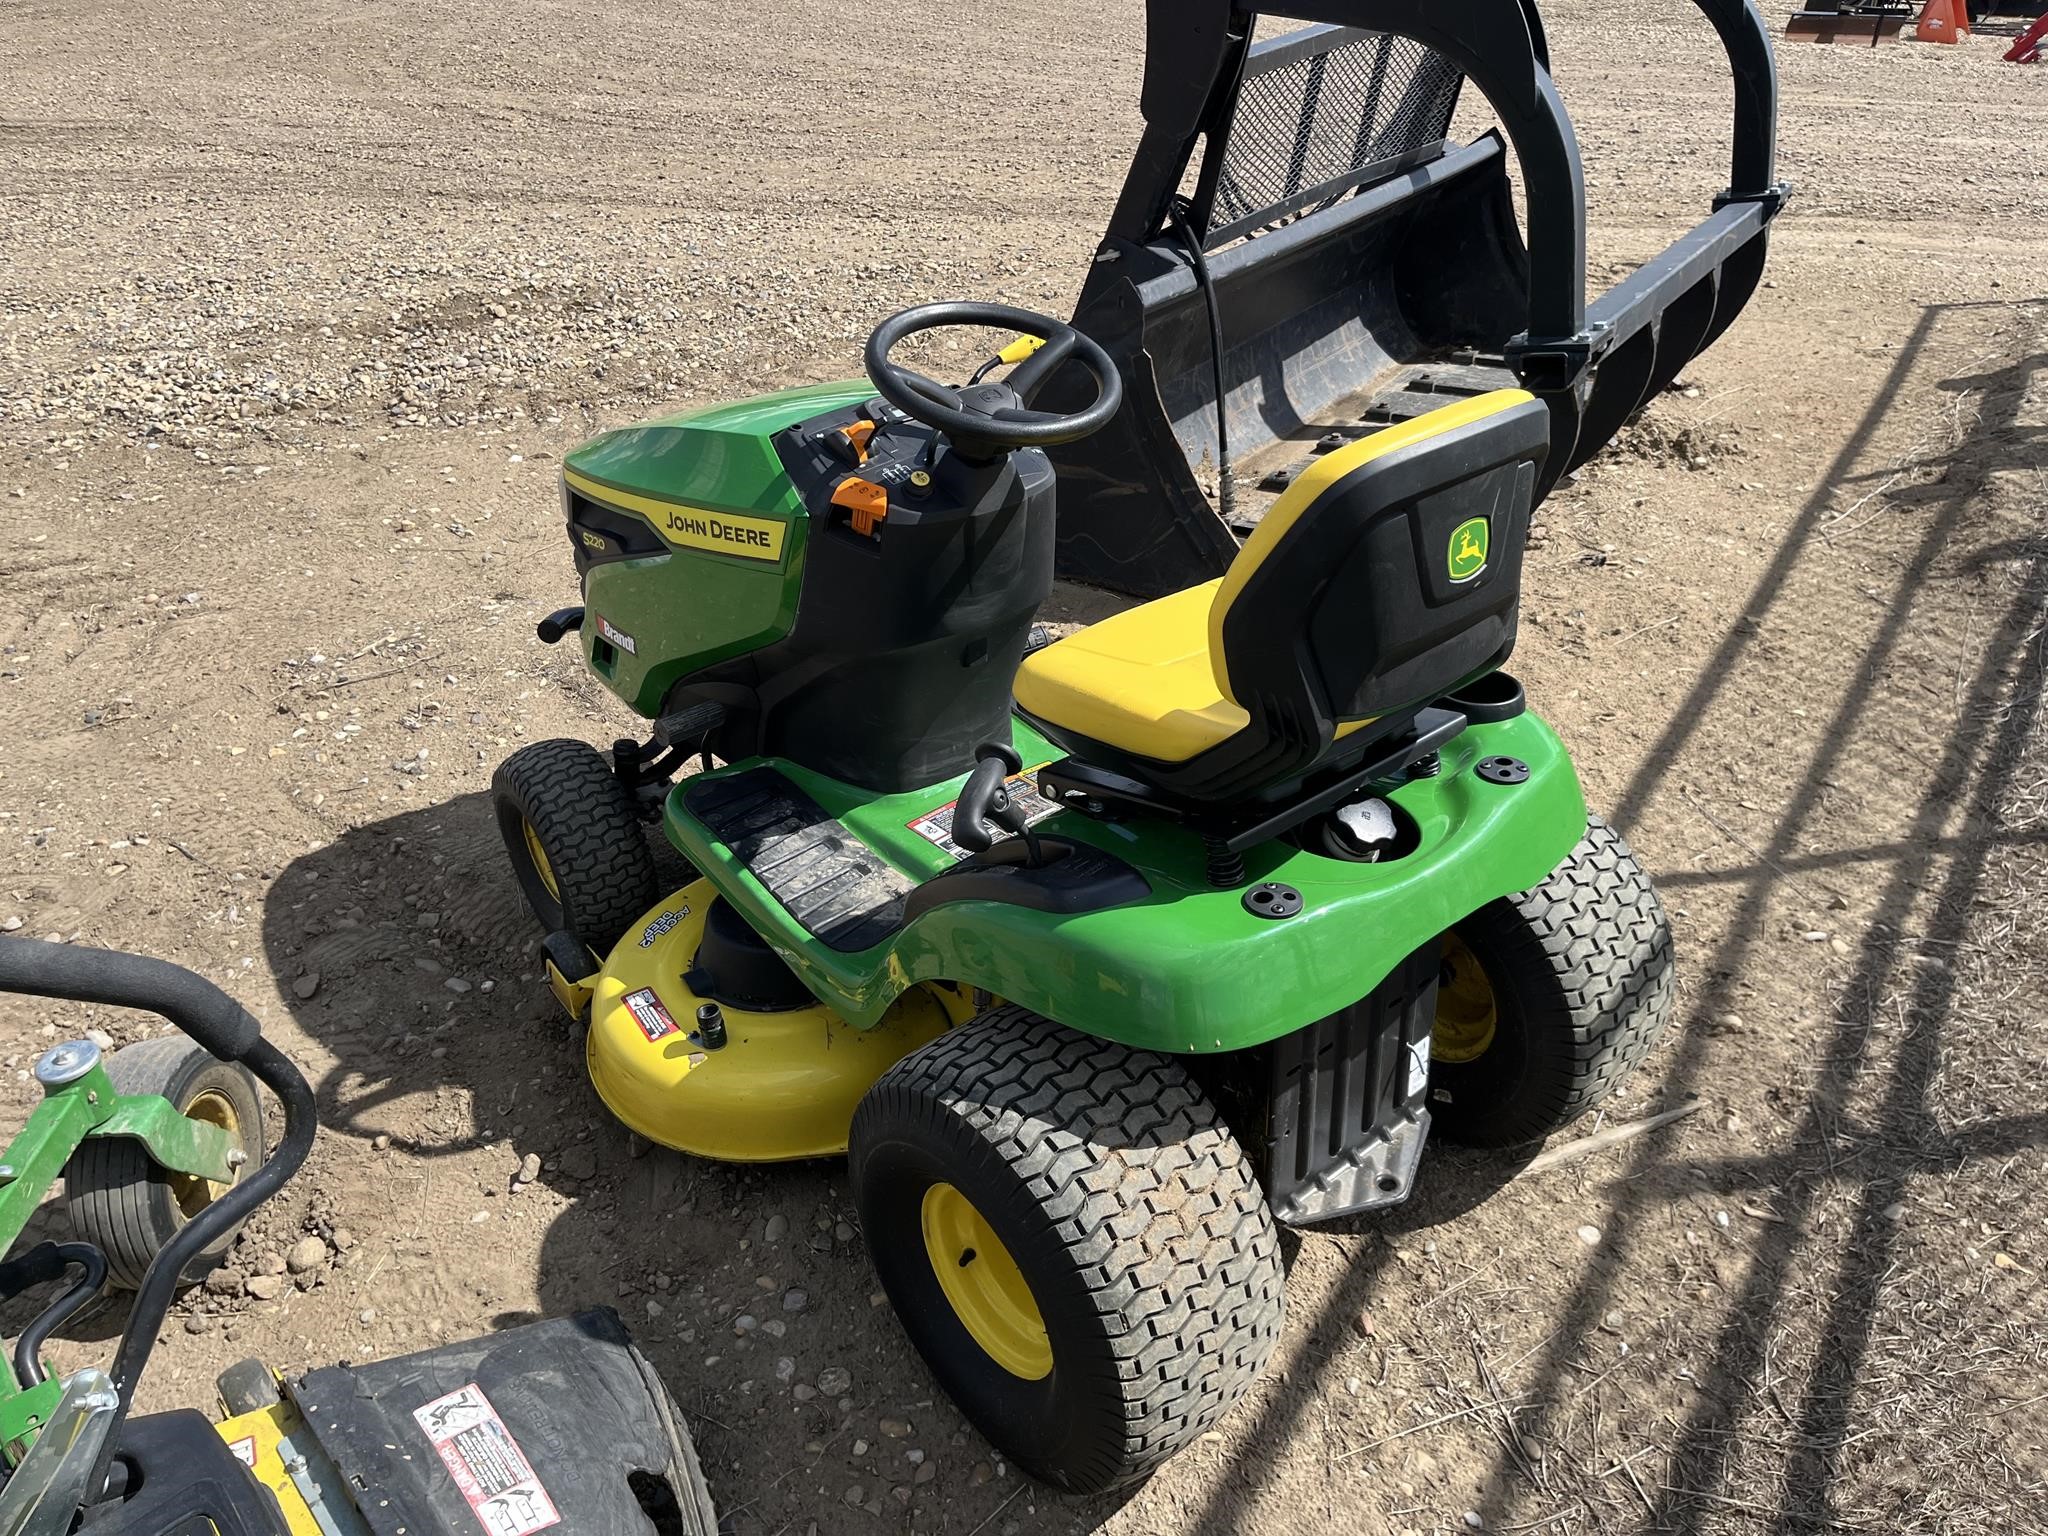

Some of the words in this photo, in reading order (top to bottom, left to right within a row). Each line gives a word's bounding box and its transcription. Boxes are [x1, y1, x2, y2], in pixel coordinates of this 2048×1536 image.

[582, 531, 605, 550] S220
[666, 511, 707, 537] JOHN
[710, 519, 771, 548] DEERE
[603, 619, 636, 654] Brandt
[644, 911, 674, 938] DEEP
[653, 906, 690, 936] ACCEL
[442, 1444, 474, 1488] DANGER
